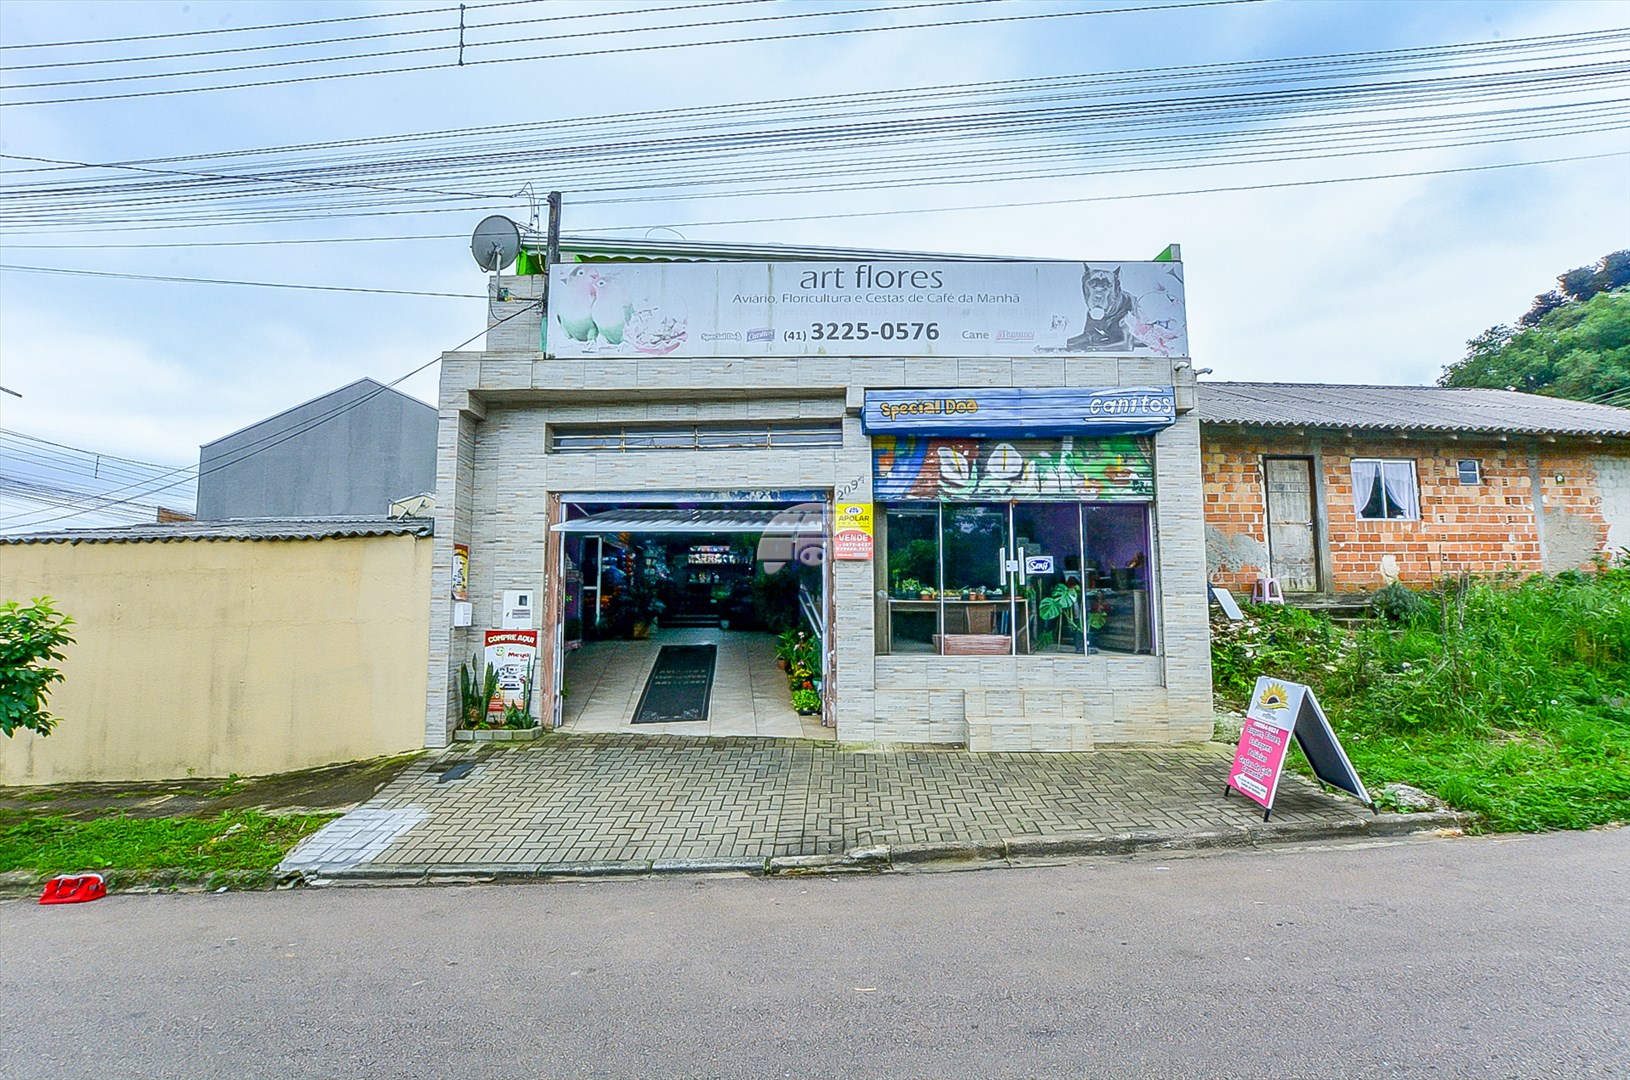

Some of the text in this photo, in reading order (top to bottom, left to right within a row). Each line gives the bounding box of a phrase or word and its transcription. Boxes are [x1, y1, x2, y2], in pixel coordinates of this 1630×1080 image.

[800, 264, 943, 289] art flores
[732, 293, 1020, 304] Aviário, Floricultura e Cestas de Café da Manhã
[783, 322, 940, 342] (41) 3225-0576
[961, 330, 989, 339] Cane
[880, 398, 979, 421] Special Dog
[838, 514, 870, 522] APOLAR
[838, 533, 868, 542] VENDE
[488, 633, 535, 643] COMPRE AQUI
